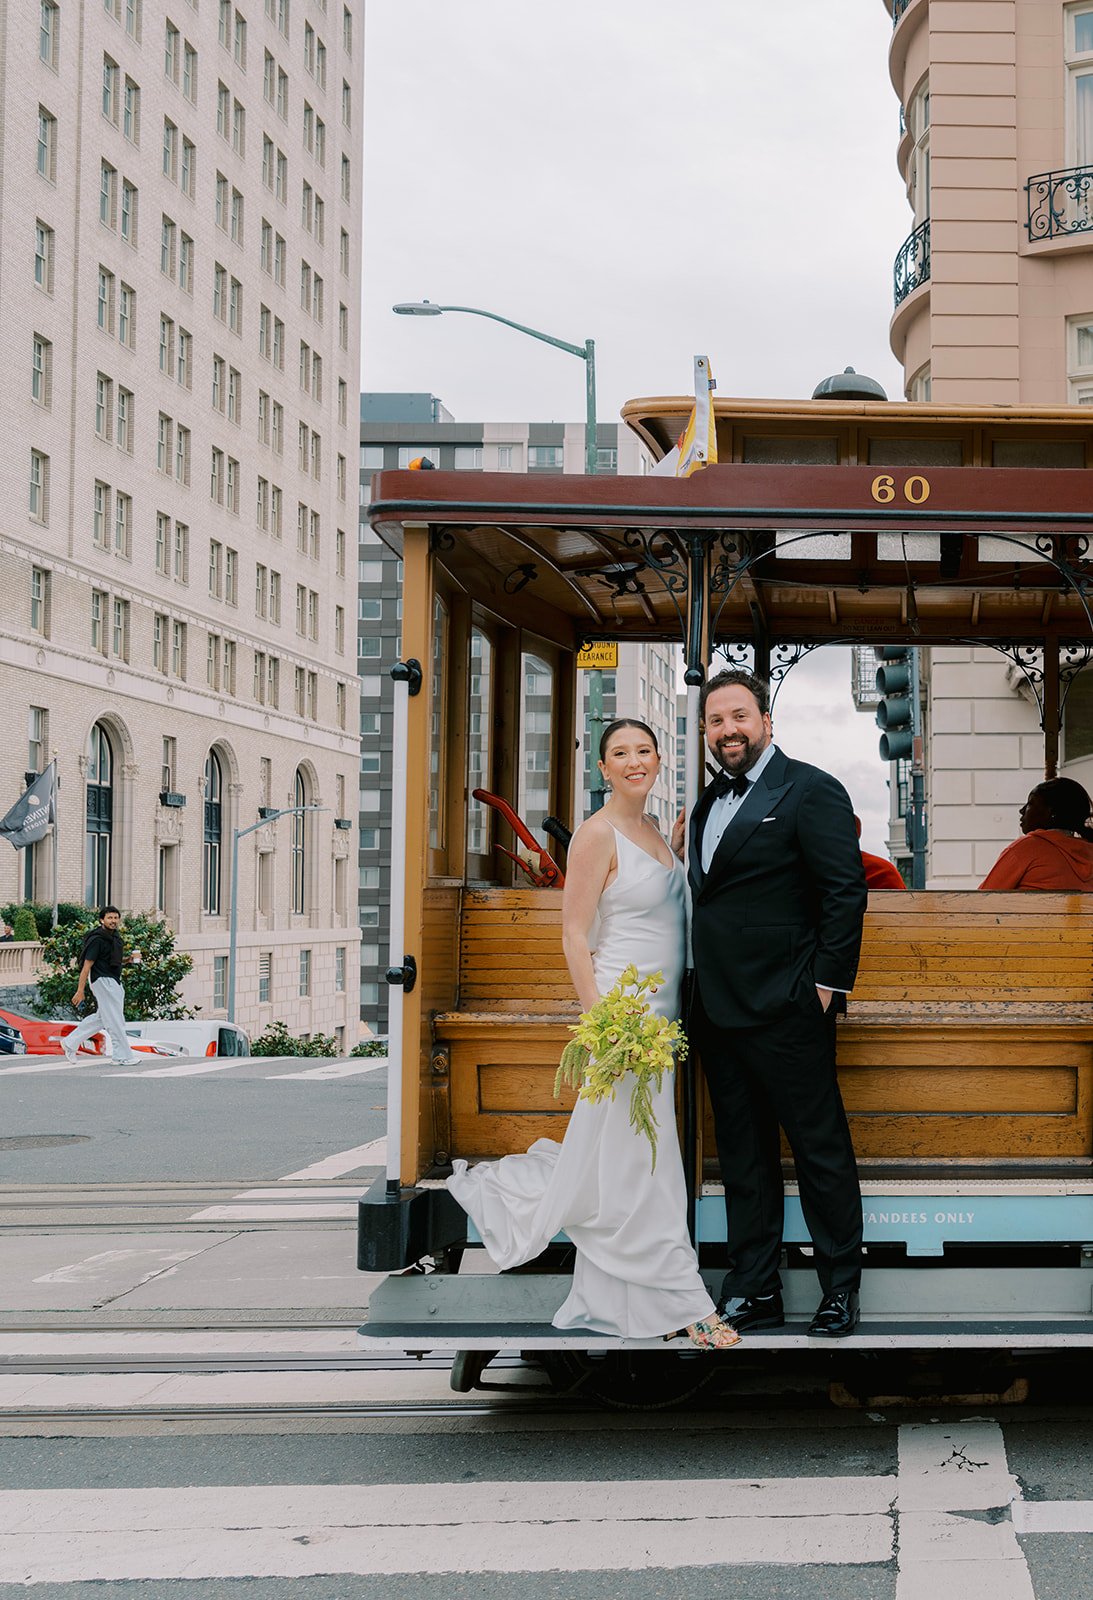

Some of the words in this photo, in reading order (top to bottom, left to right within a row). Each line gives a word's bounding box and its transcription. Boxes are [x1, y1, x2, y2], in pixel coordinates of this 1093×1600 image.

[871, 475, 931, 504] 60
[588, 641, 616, 649] ROUND
[578, 652, 613, 661] LEARANCE
[862, 1212, 927, 1224] TANDEES
[934, 1212, 975, 1224] ONLY
